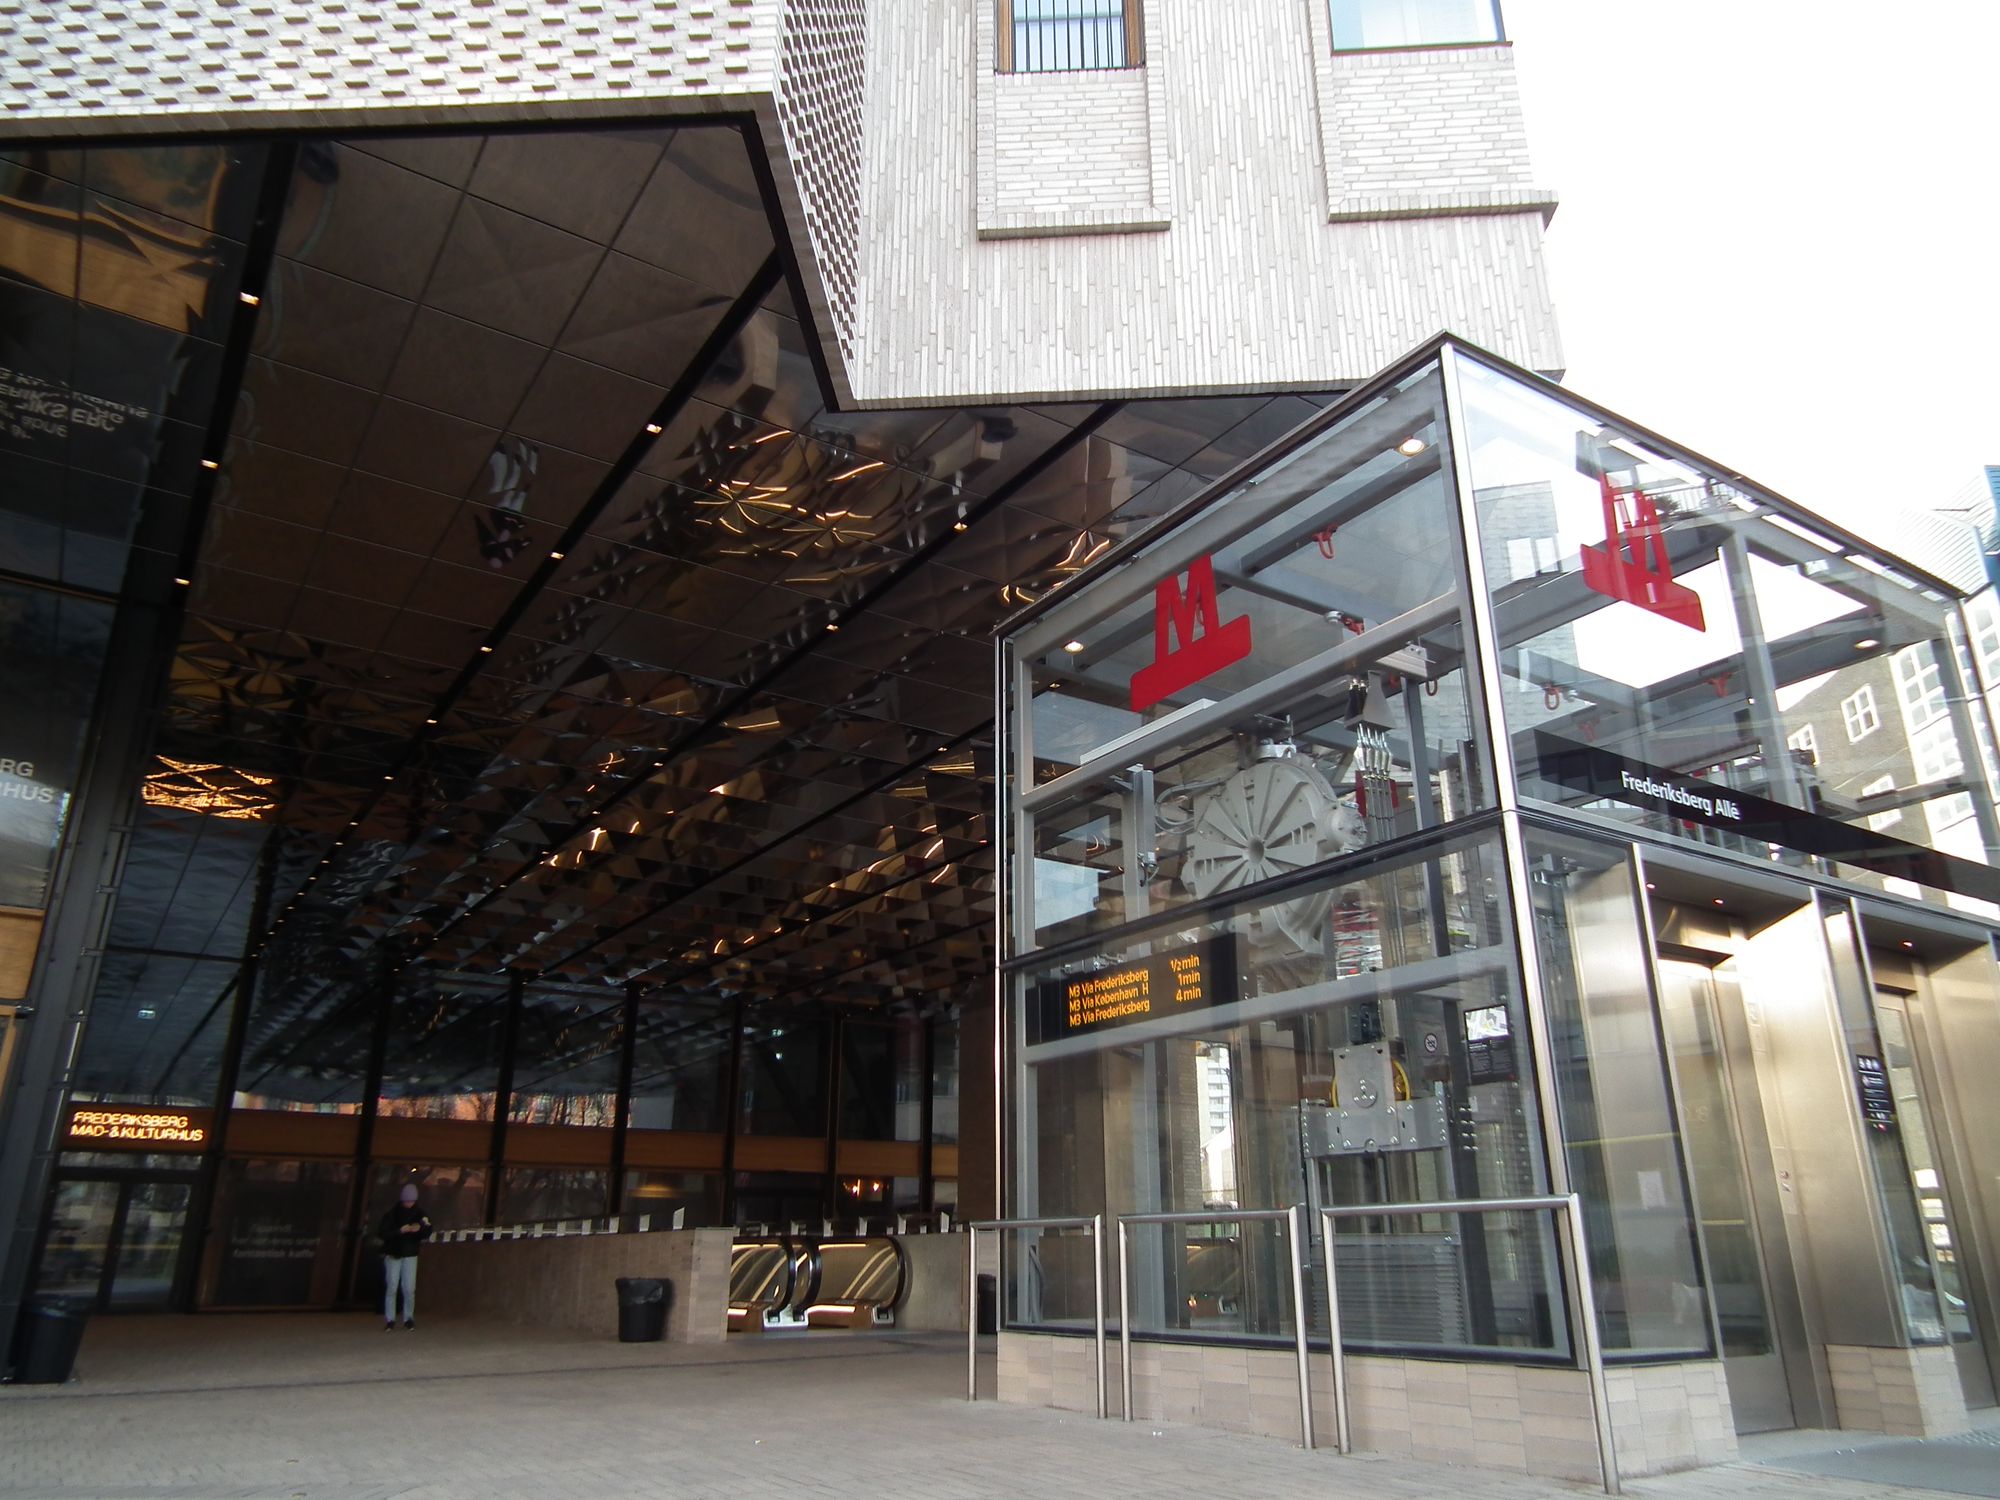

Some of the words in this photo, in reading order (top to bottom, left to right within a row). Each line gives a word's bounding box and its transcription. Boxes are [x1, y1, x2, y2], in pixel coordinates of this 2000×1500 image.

[1620, 770, 1713, 817] Frederiksberg
[1715, 798, 1741, 820] Allé
[1069, 985, 1081, 998] M3
[1082, 980, 1094, 995] Via
[1094, 969, 1149, 992] Frederiksberg
[1069, 1000, 1082, 1012] M3
[1082, 996, 1094, 1009] Via
[1094, 987, 1139, 1006] København
[1142, 983, 1149, 995] H
[1069, 1014, 1082, 1027] M3
[1083, 1010, 1095, 1024] Via
[1095, 999, 1150, 1020] Frederiksberg
[70, 1124, 109, 1137] MAD-
[119, 1126, 203, 1141] KULTURHUS
[73, 1111, 188, 1128] FREDERIKSBERG
